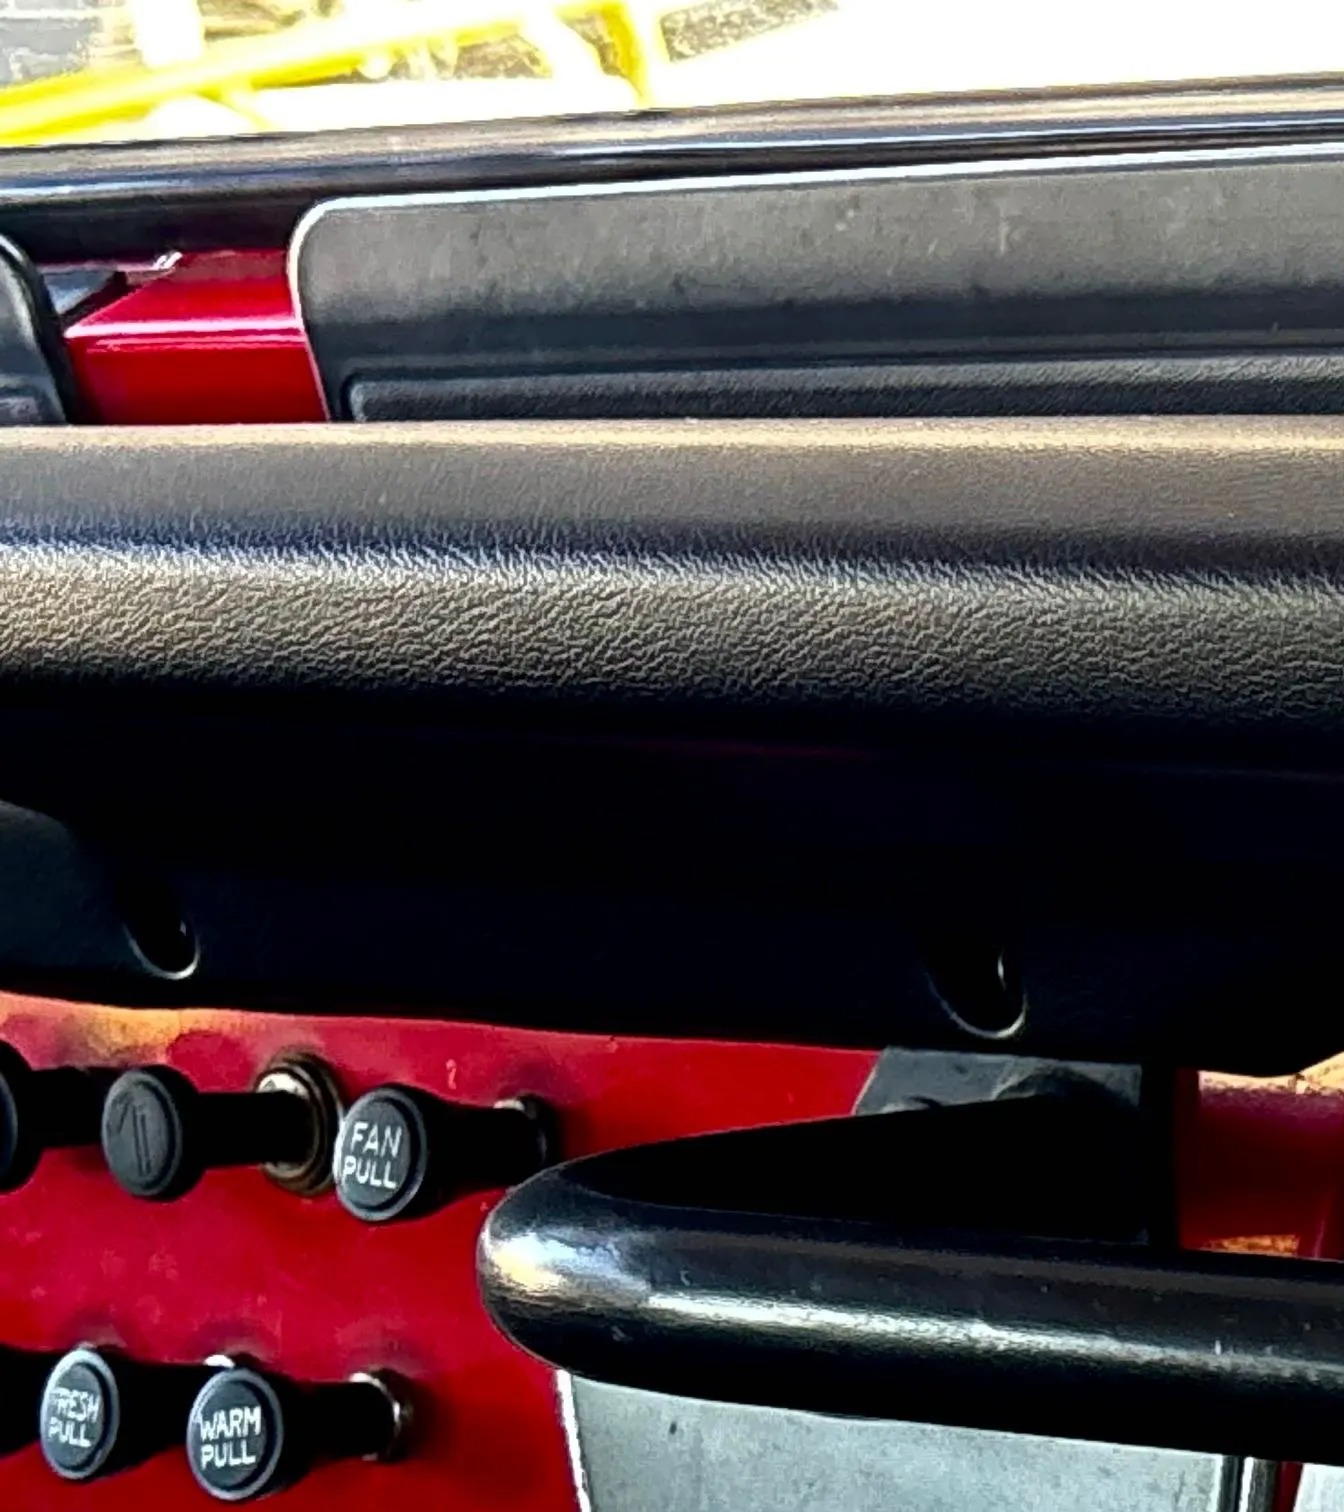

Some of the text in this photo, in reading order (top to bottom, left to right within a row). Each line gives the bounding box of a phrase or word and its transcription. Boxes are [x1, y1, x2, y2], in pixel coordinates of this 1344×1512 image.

[351, 1121, 402, 1158] FAN
[341, 1155, 397, 1189] PULL
[49, 1387, 100, 1422] FRESH
[49, 1416, 91, 1447] PULL
[200, 1406, 261, 1441] WARM
[201, 1439, 256, 1470] PULL
